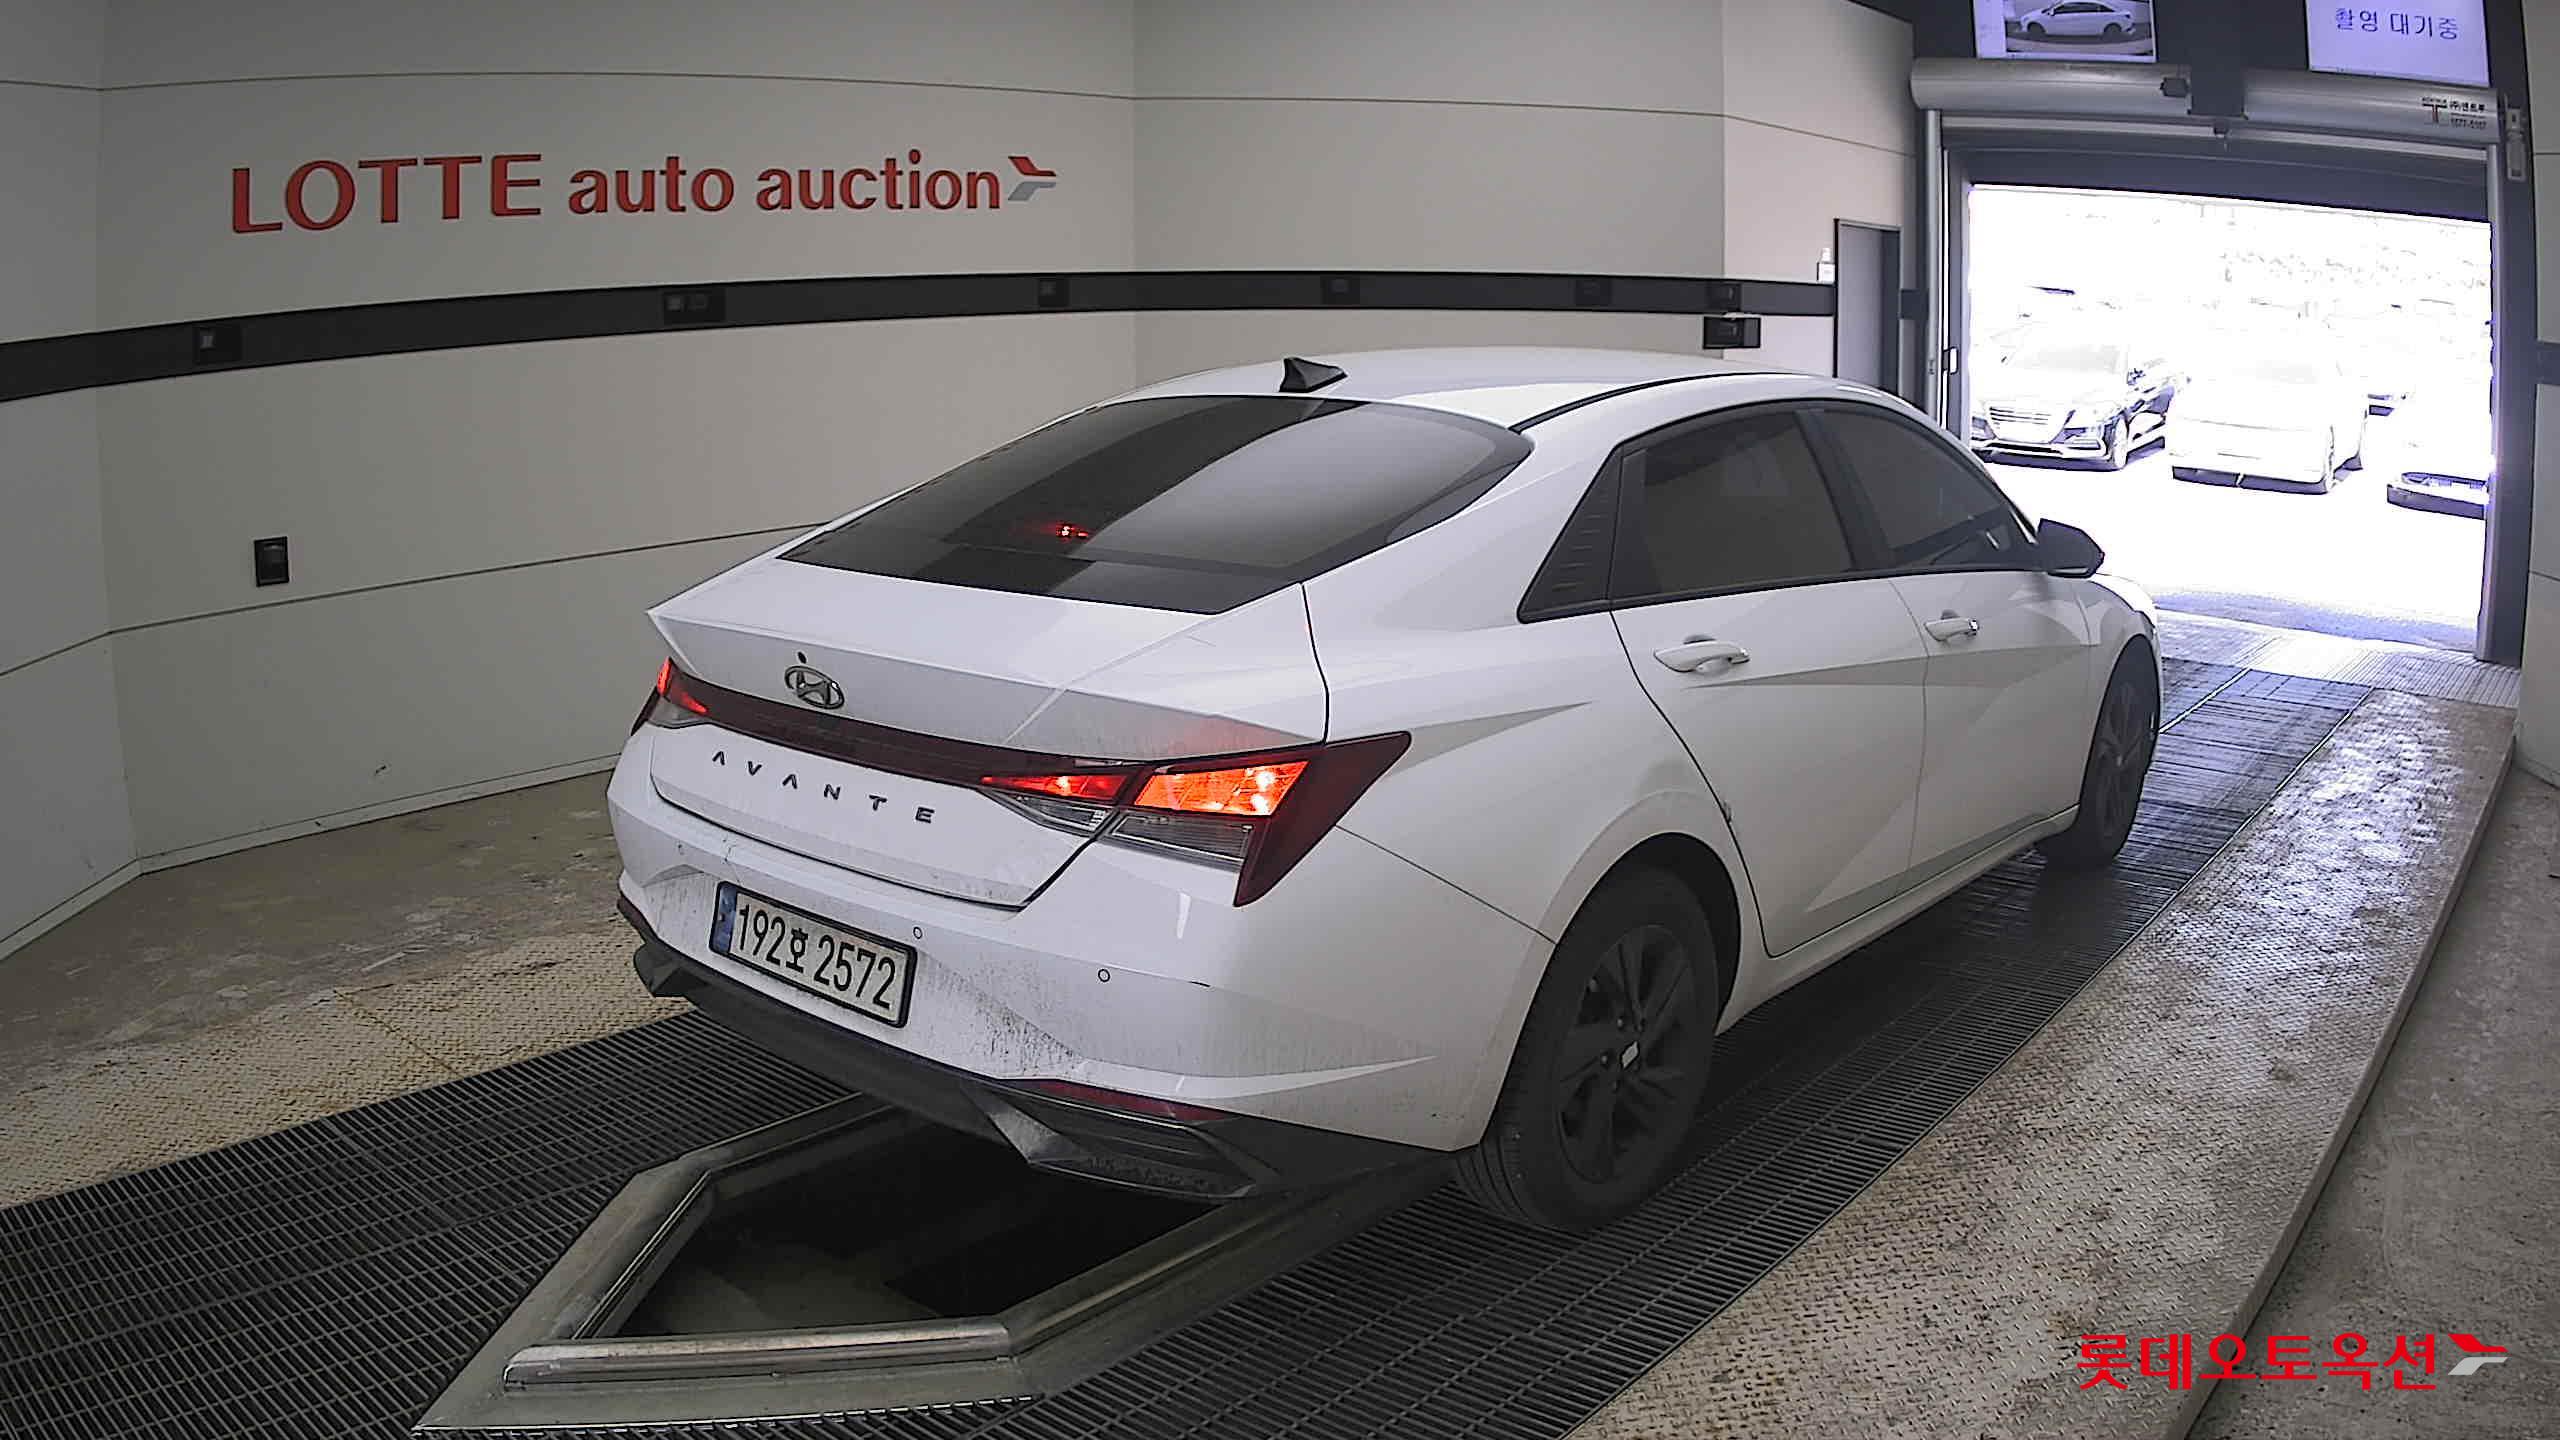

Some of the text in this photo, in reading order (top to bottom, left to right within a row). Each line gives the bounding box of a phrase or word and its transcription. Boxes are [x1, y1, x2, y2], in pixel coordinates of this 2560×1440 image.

[2389, 12, 2459, 41] 대기중
[231, 149, 1003, 234] LOTTE auto auction
[711, 750, 936, 825] AVANTE
[738, 903, 897, 1011] 192호 2572
